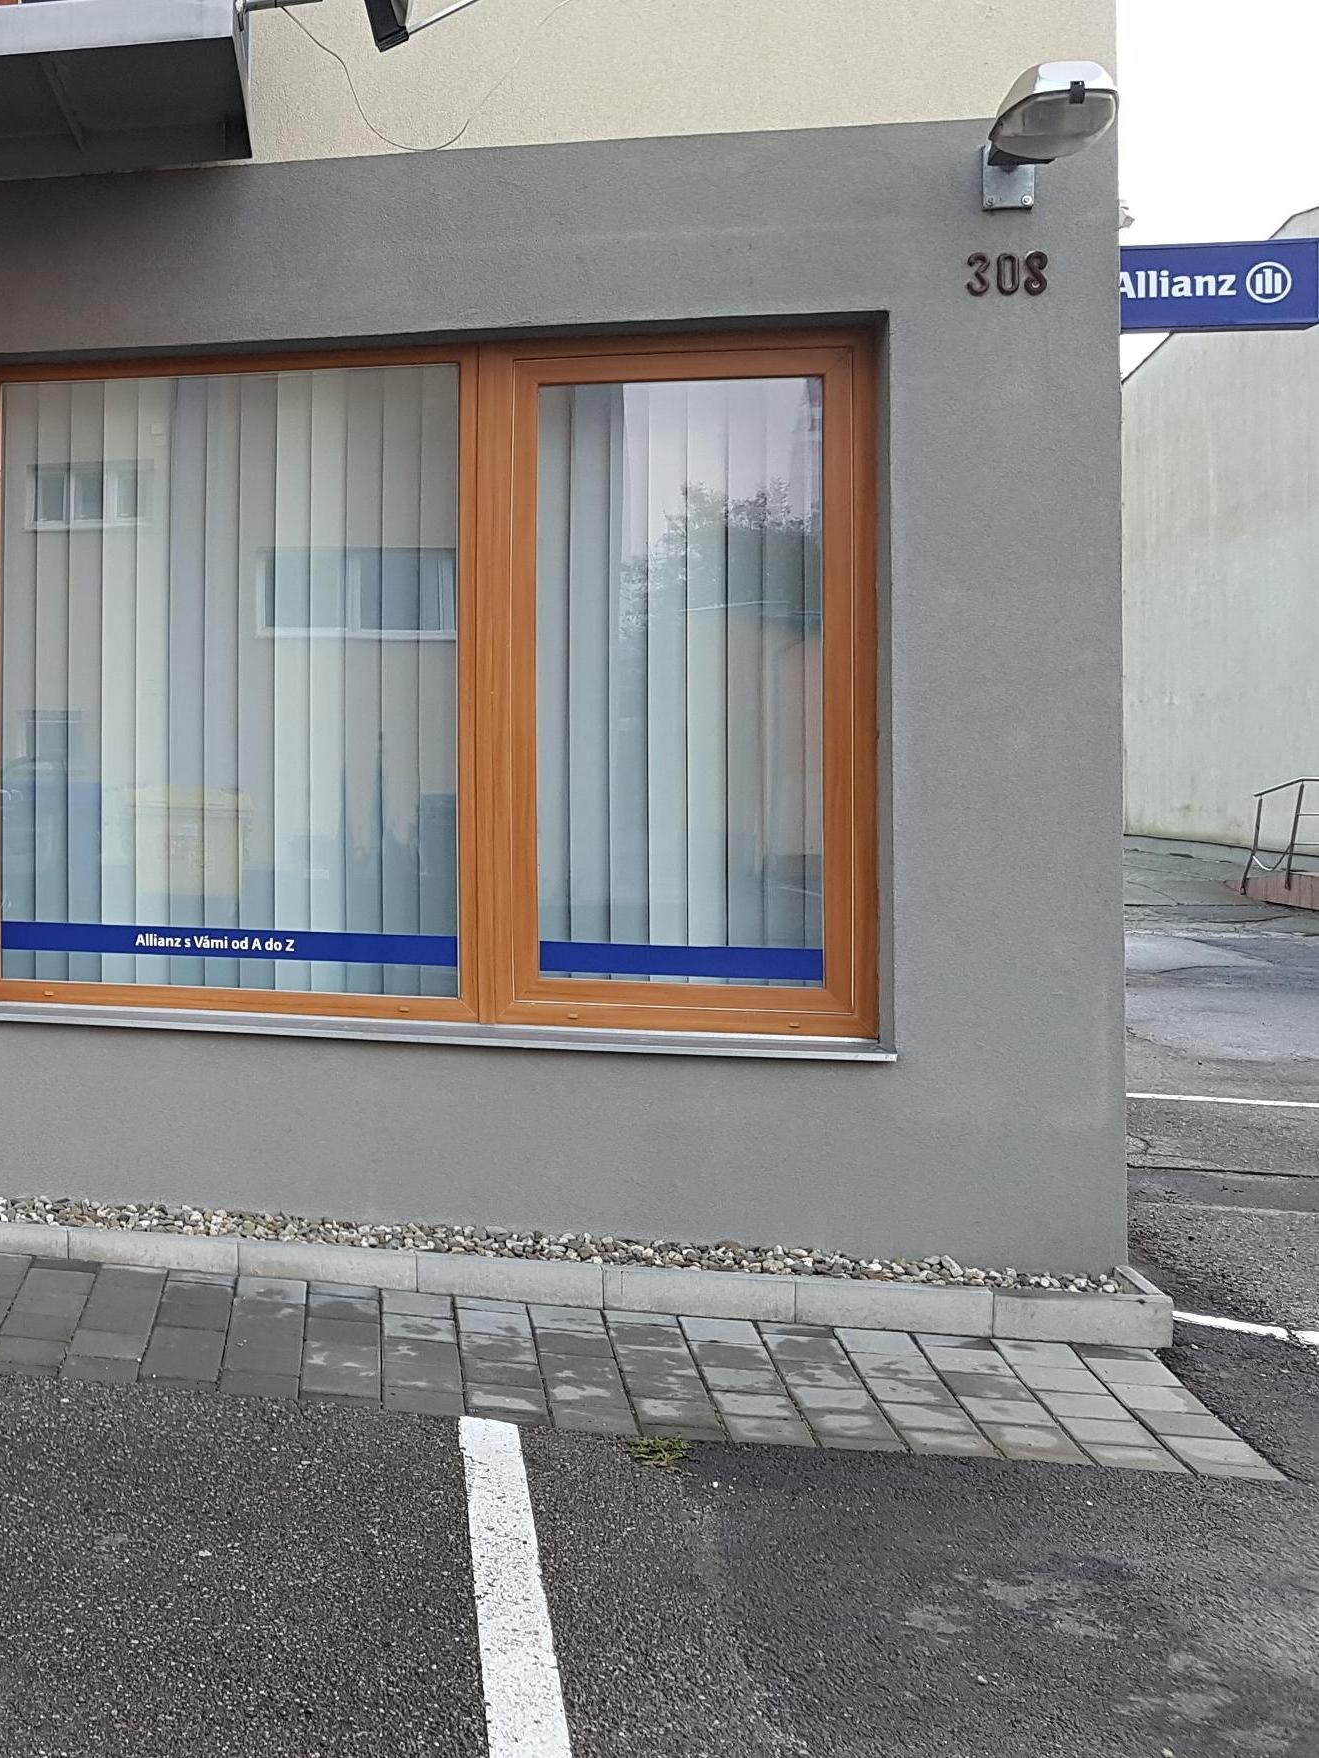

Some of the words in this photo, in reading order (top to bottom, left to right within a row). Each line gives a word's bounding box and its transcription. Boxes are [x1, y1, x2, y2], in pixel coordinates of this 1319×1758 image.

[965, 250, 1049, 297] 308
[1118, 269, 1237, 299] Allianz
[135, 933, 181, 948] Allianz
[184, 937, 192, 948] s
[193, 934, 229, 950] Vámi
[231, 935, 249, 951] od
[251, 937, 262, 951] A
[264, 937, 284, 952] do
[285, 938, 295, 952] Z
